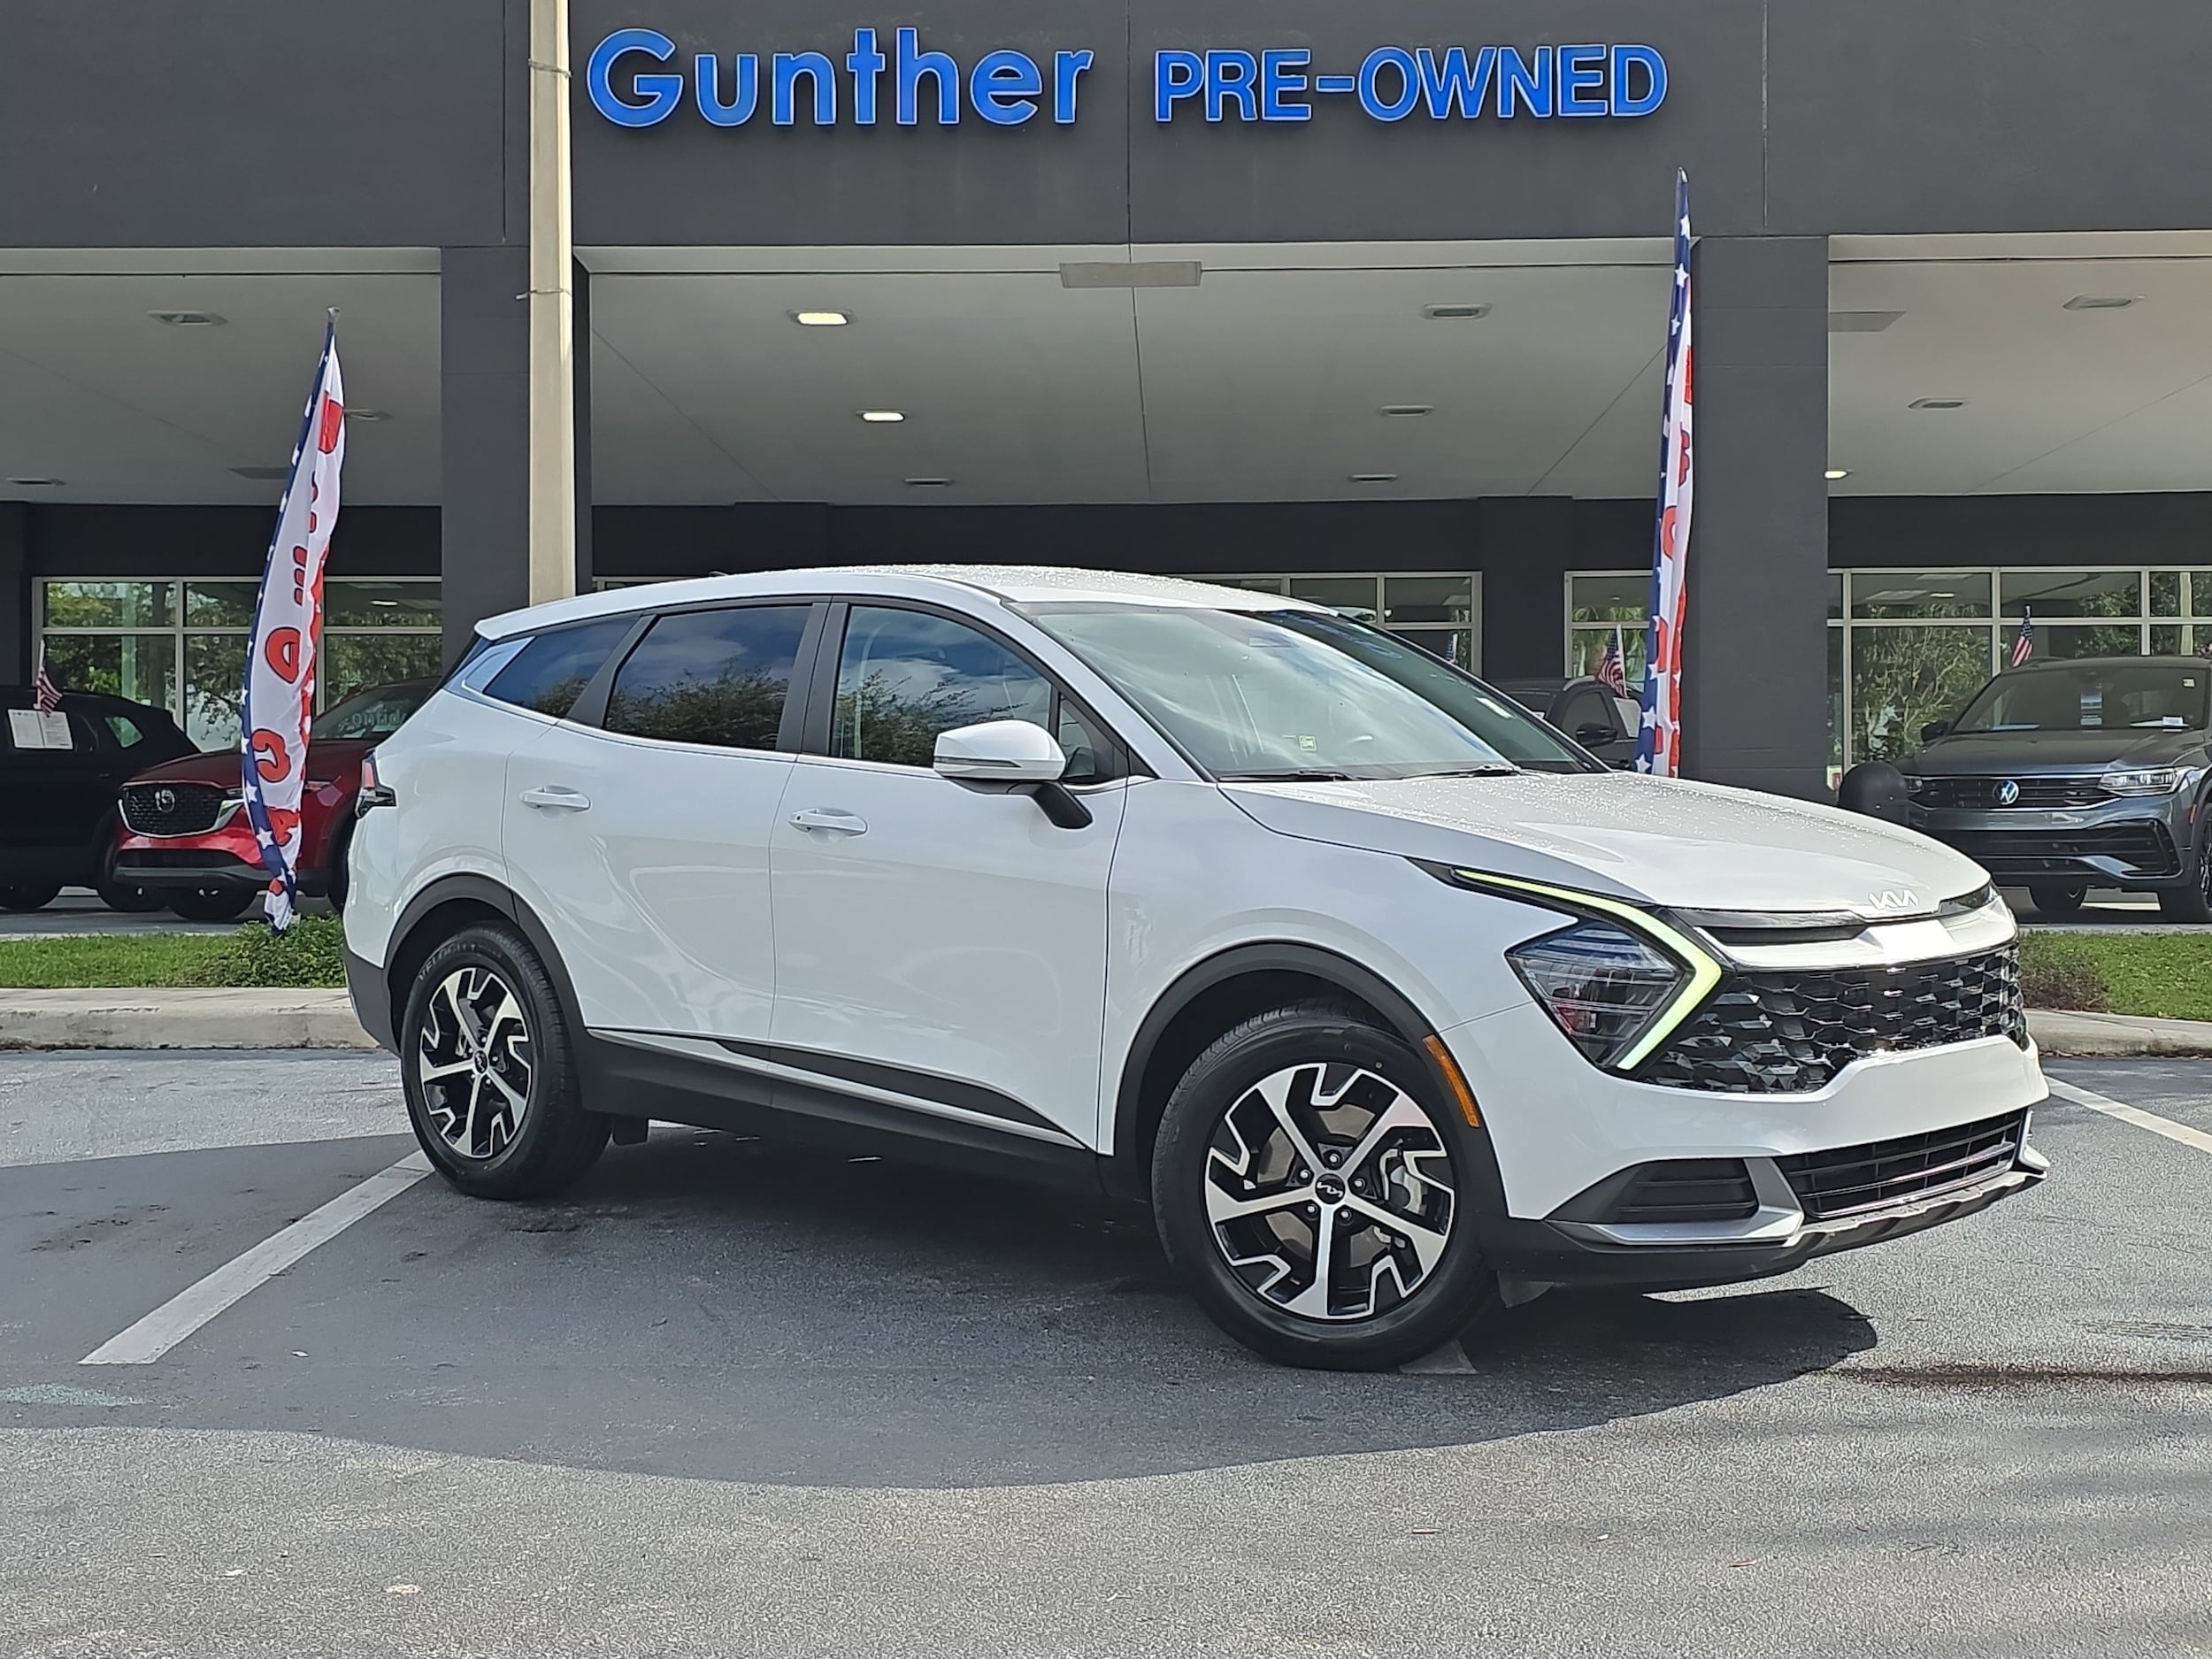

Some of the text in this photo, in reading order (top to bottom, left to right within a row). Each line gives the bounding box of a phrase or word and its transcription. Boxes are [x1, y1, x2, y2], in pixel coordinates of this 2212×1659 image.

[588, 27, 1668, 127] Gunther PRE-OWNED
[1868, 888, 1919, 910] KIA
